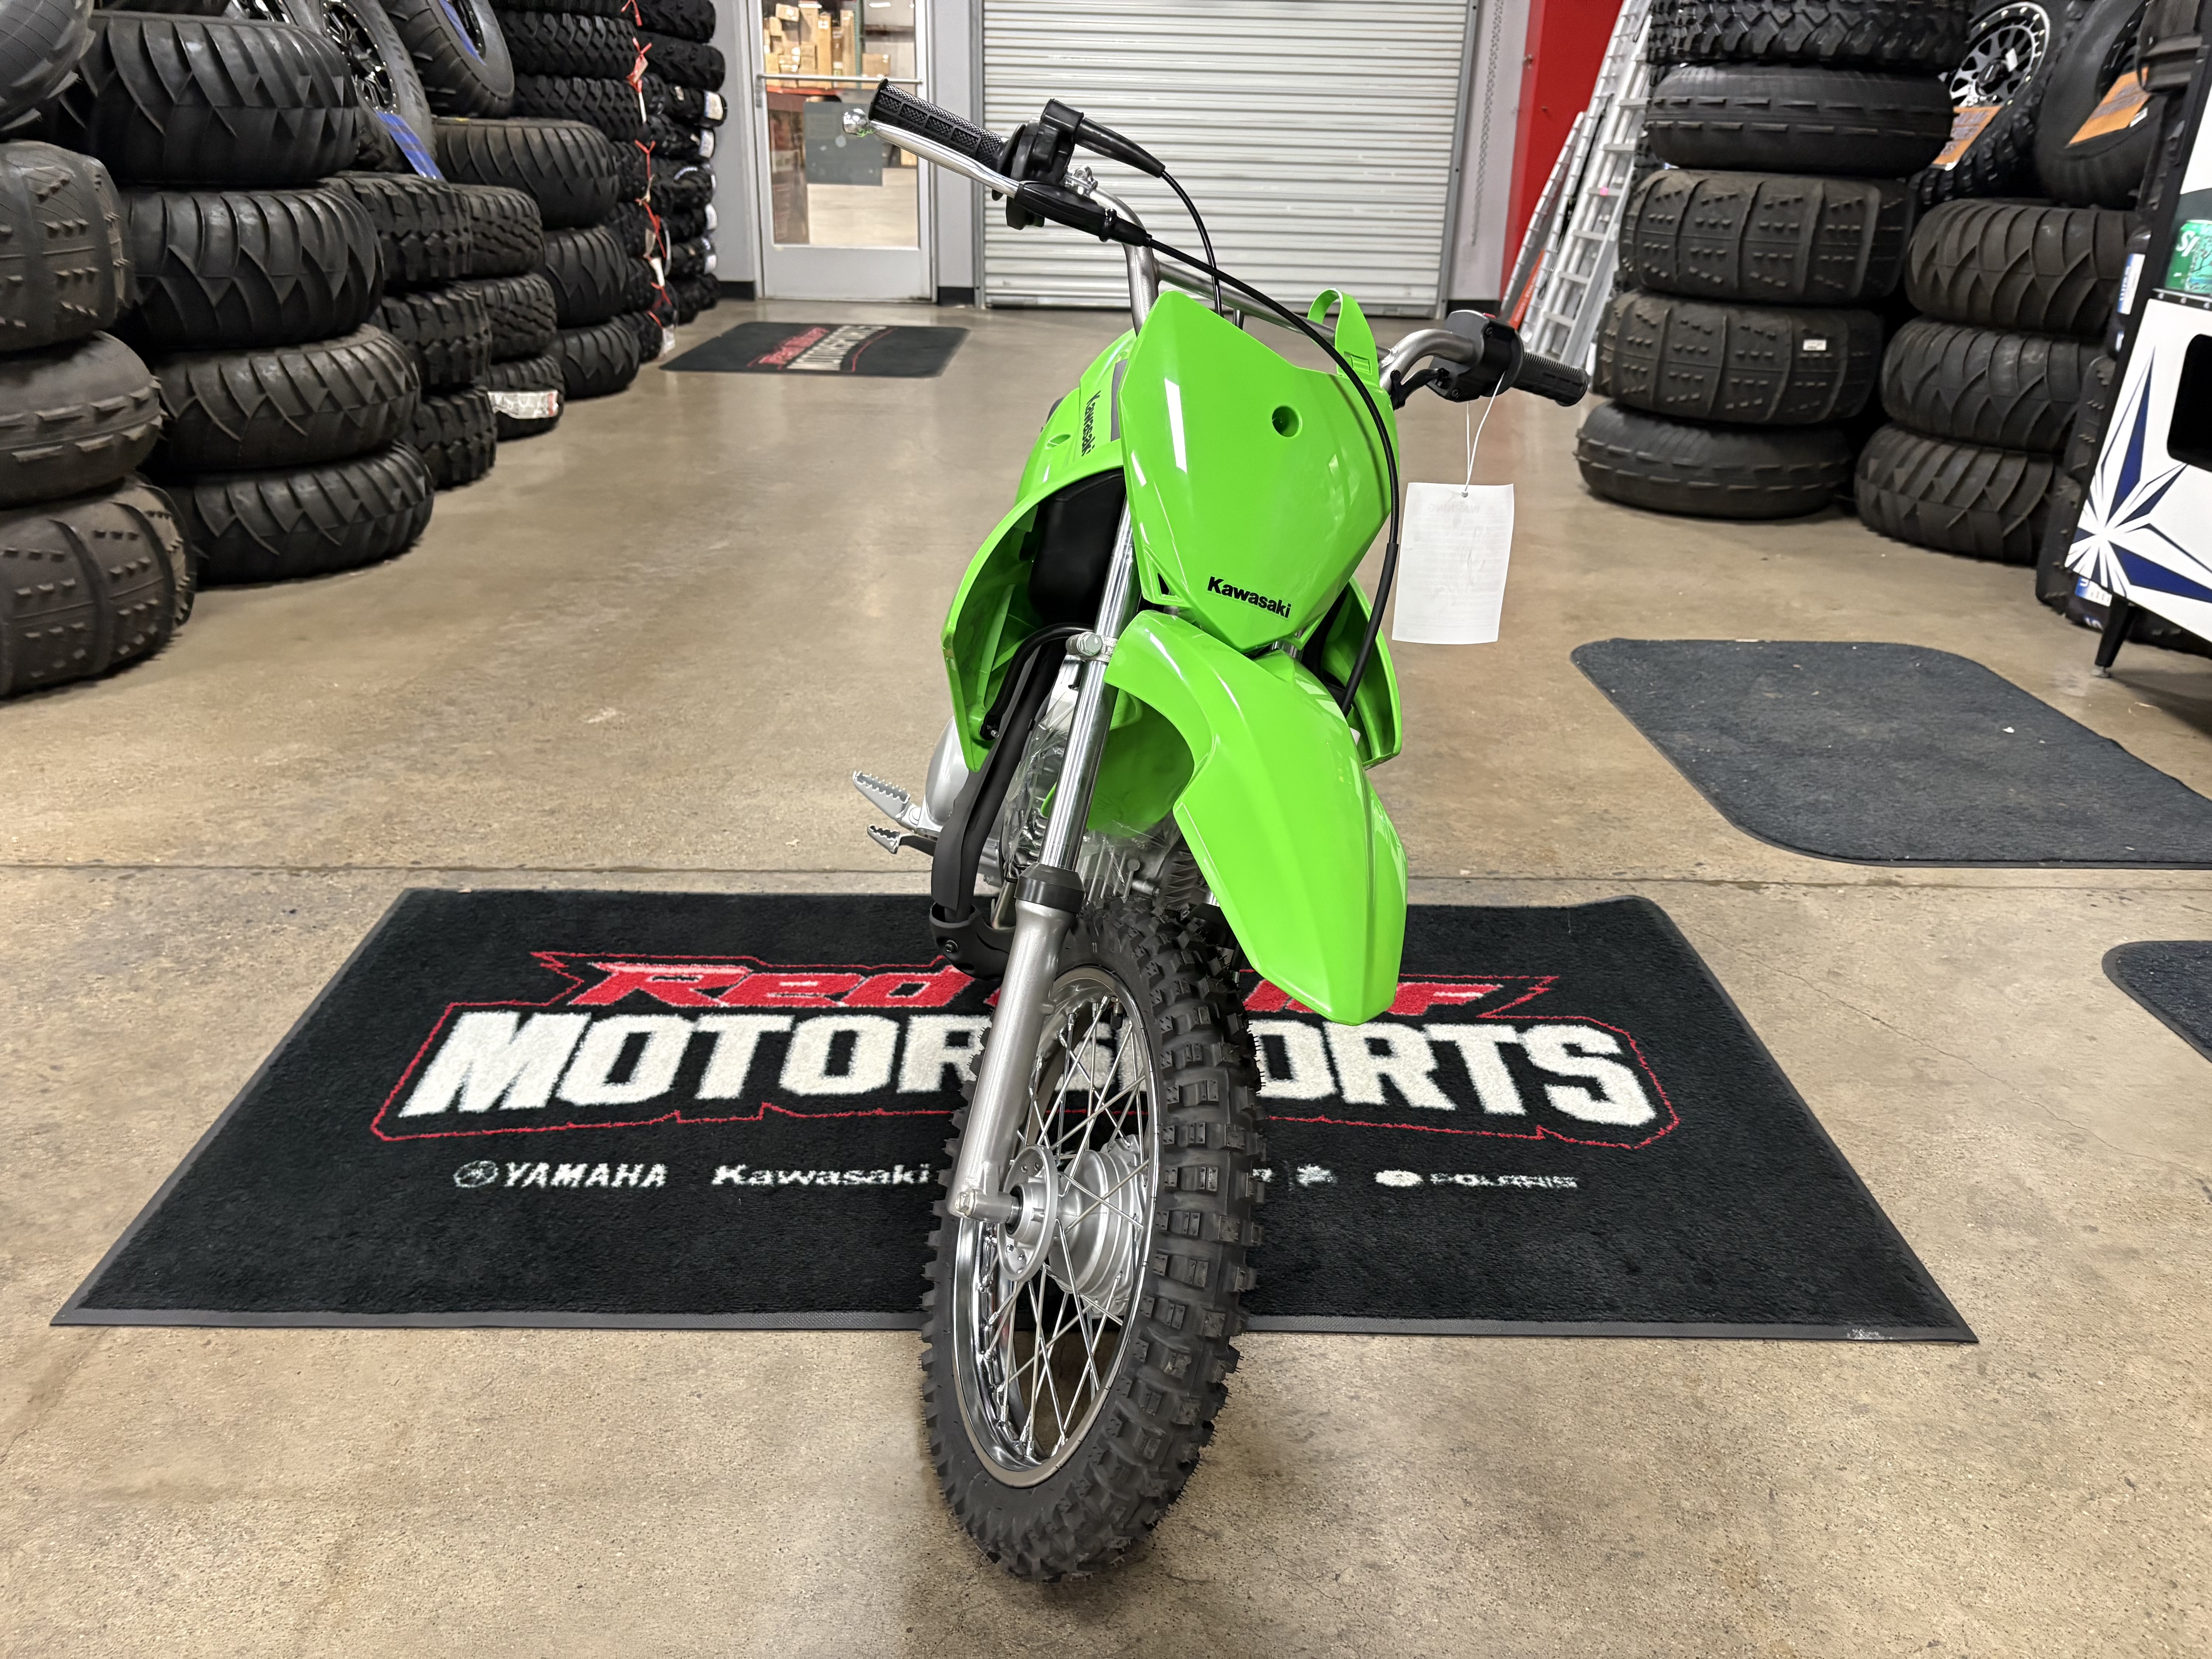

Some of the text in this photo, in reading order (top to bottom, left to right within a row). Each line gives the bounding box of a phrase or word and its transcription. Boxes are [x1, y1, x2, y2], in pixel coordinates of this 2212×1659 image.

[1082, 390, 1101, 457] Kawasaki
[1207, 576, 1291, 618] Kawasaki
[505, 1162, 668, 1188] YAMAHA
[711, 1163, 930, 1186] Kawasaki
